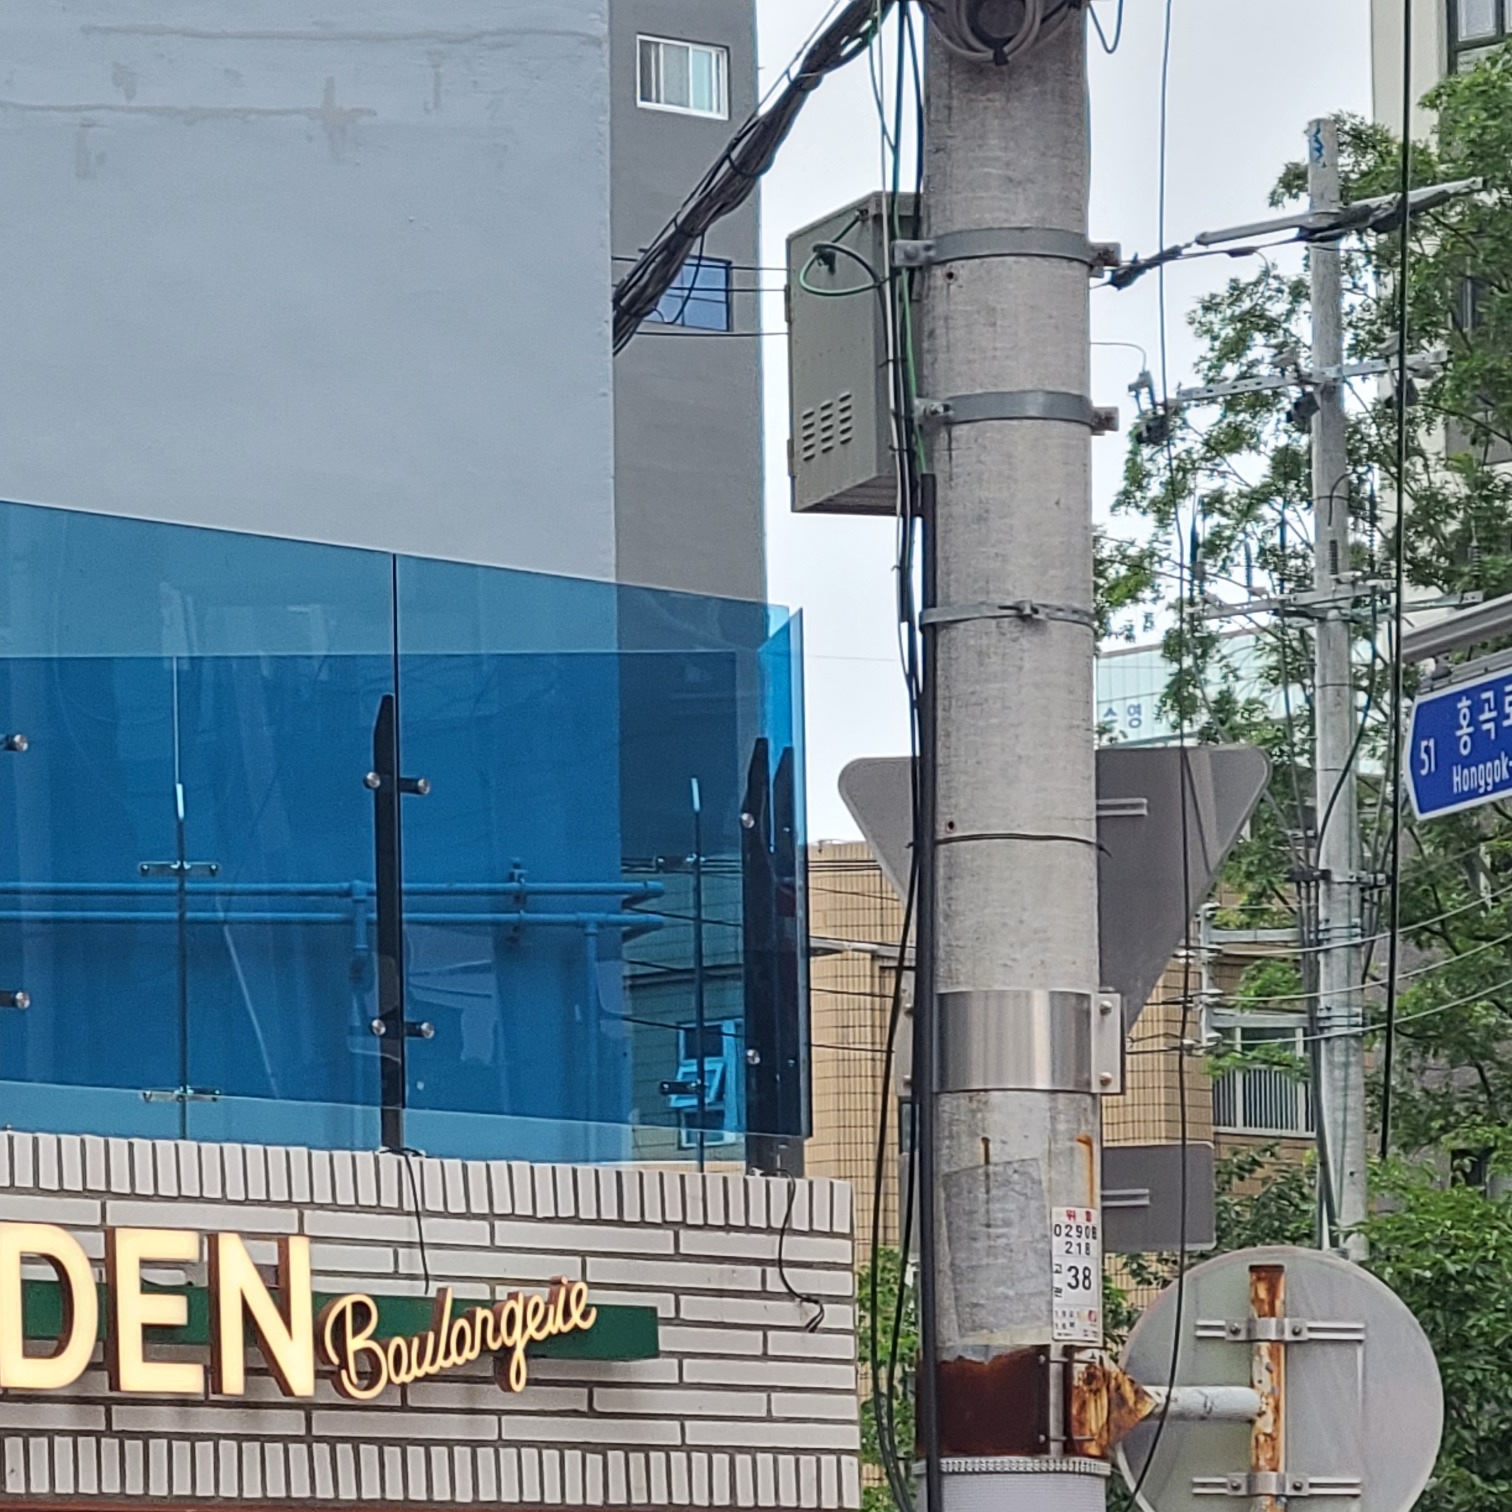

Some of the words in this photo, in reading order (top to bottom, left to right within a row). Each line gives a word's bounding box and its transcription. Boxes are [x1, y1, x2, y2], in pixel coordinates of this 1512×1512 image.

[1419, 737, 1436, 776] 51
[1067, 1265, 1092, 1291] 38
[319, 1276, 598, 1400] Boulangerie
